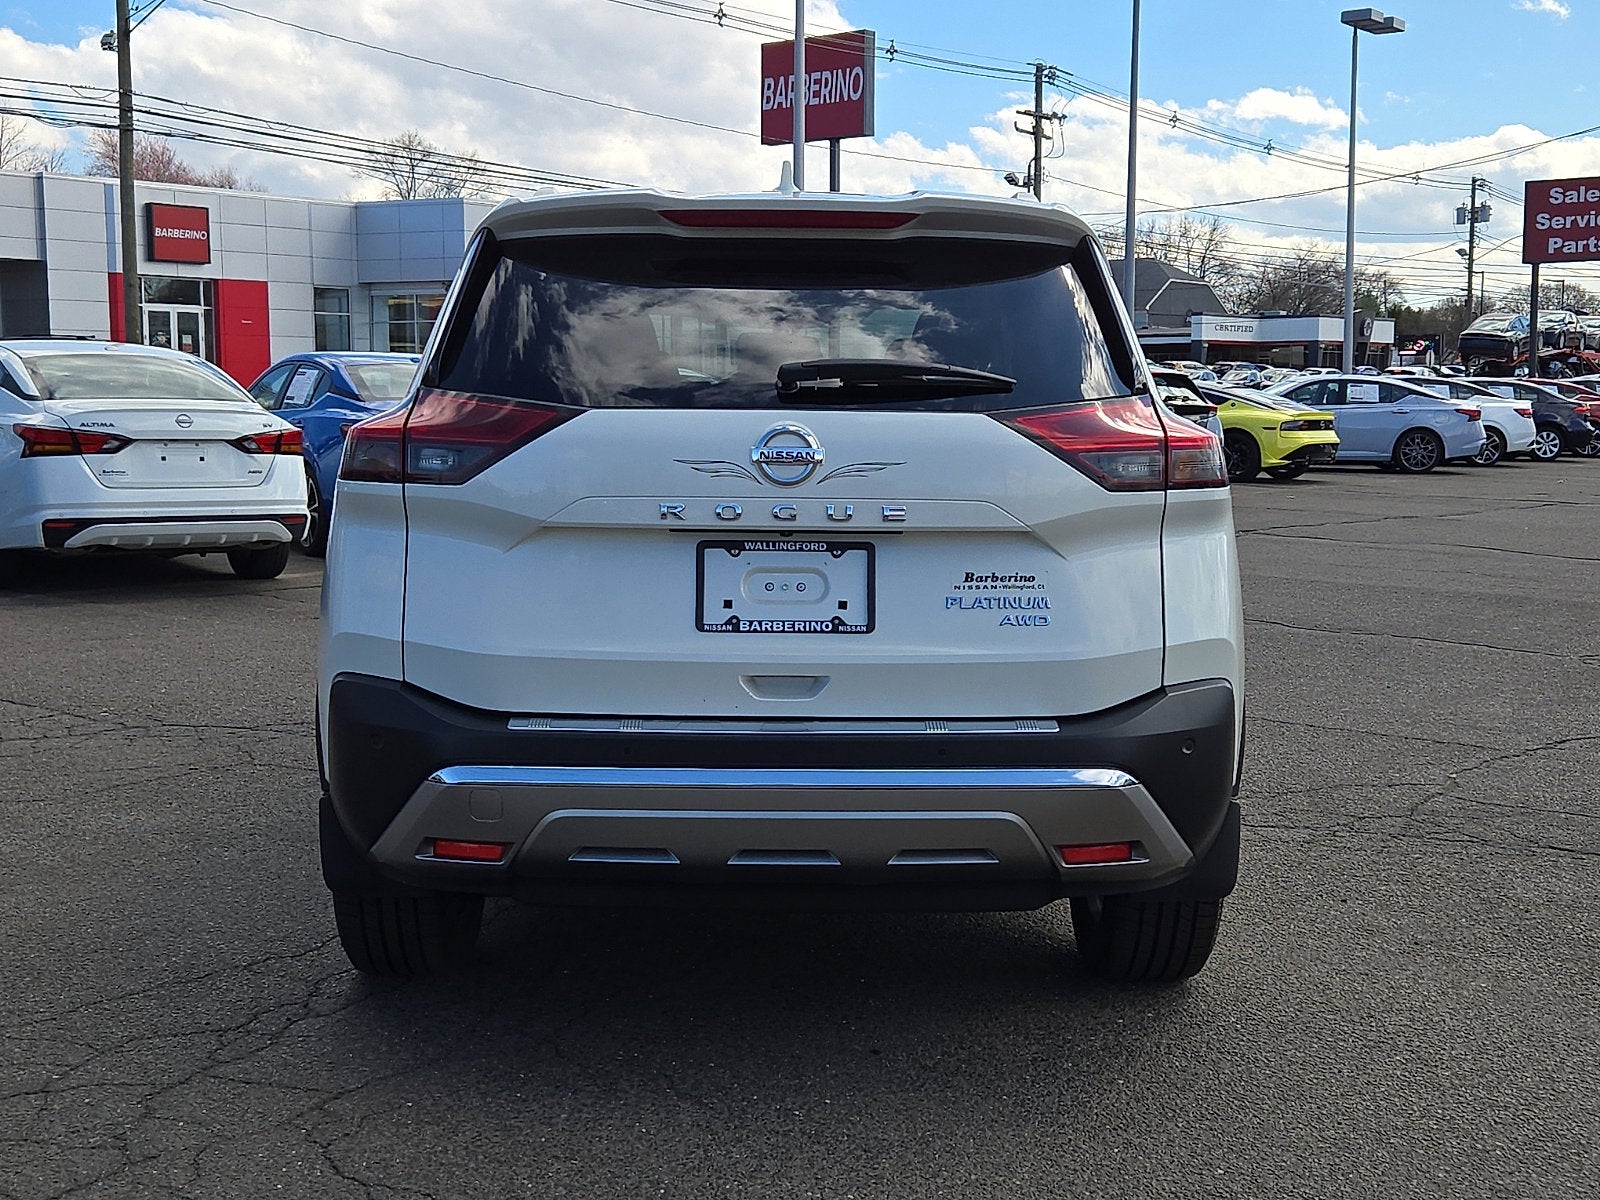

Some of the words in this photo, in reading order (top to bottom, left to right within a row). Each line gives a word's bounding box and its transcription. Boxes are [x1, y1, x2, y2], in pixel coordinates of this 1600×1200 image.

[154, 227, 208, 240] BARBERINO
[1547, 236, 1600, 254] Part
[1214, 324, 1254, 333] CERTIFIED
[759, 450, 817, 461] NISSAN
[659, 503, 907, 522] ROGUE
[744, 541, 827, 551] WALLINGFORD
[962, 571, 1036, 583] Barberino
[945, 596, 1051, 609] PLATINUM
[739, 620, 832, 631] BARBERINO
[999, 614, 1051, 626] AWD
